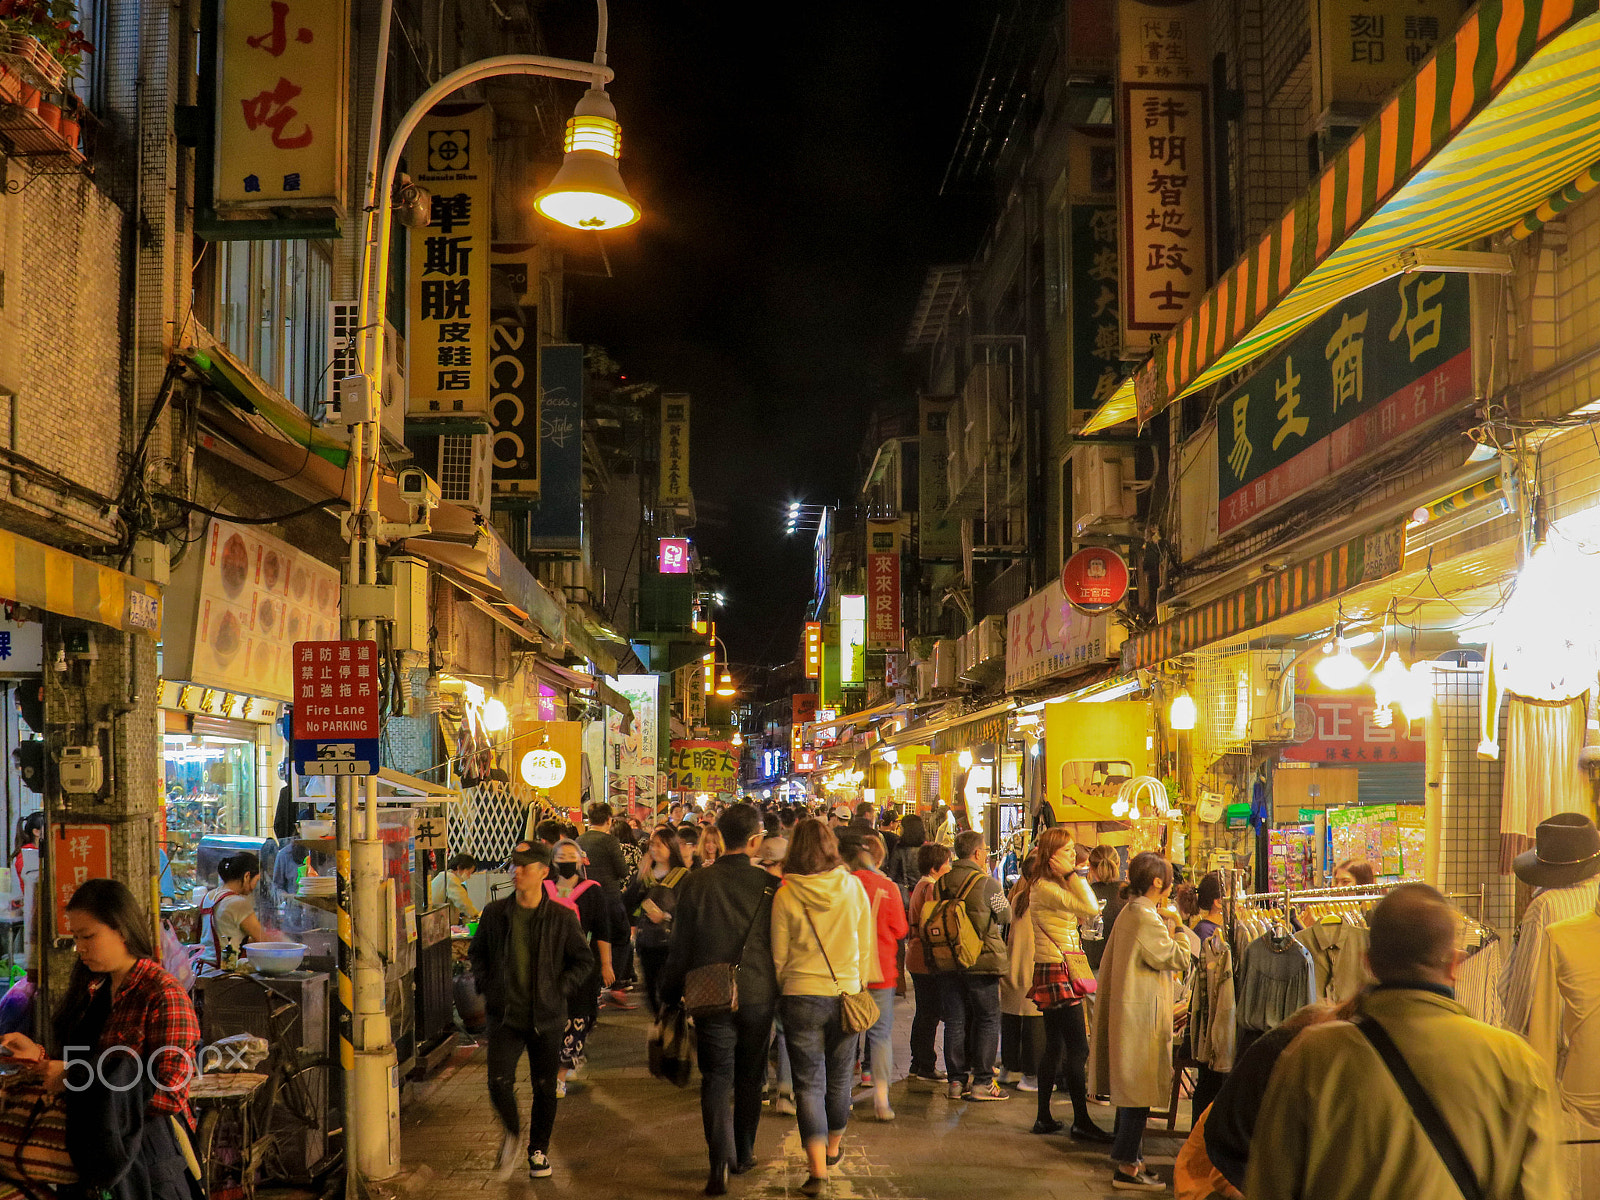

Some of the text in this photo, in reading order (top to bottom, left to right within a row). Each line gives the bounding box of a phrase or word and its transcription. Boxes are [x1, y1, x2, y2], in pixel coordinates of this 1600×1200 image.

[1350, 14, 1385, 65] 刻印
[241, 1, 313, 149] 小吃
[1142, 96, 1194, 311] 許明智地政士
[1227, 273, 1446, 482] 易生商店
[875, 556, 893, 630] 來來皮鞋
[301, 646, 370, 662] 消防通道
[302, 664, 371, 680] 禁止停車
[302, 682, 371, 699] 加強拖吊
[306, 704, 365, 716] Fire Lane
[306, 720, 368, 732] No PARKING
